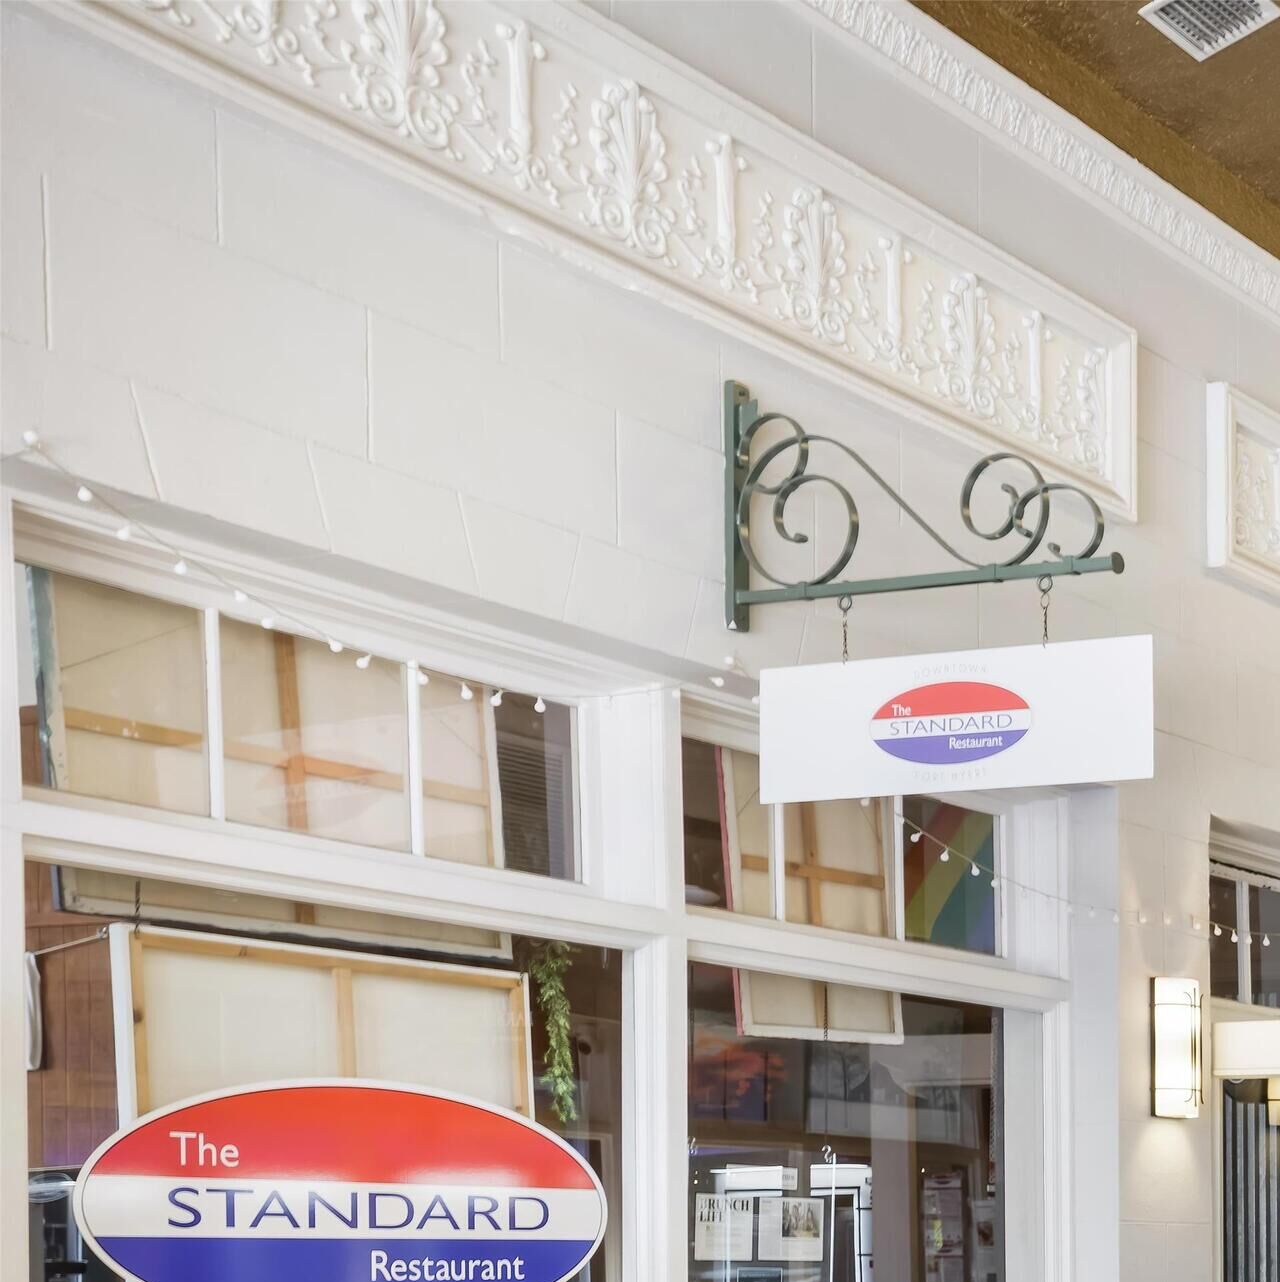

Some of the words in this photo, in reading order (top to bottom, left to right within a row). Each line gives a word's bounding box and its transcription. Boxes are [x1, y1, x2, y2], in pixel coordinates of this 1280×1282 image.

[890, 713, 1013, 736] STANDARD
[892, 704, 911, 717] The
[949, 736, 1003, 750] Restaurant
[170, 1131, 240, 1167] The
[167, 1186, 549, 1230] STANDARD
[371, 1249, 525, 1282] Restaurant
